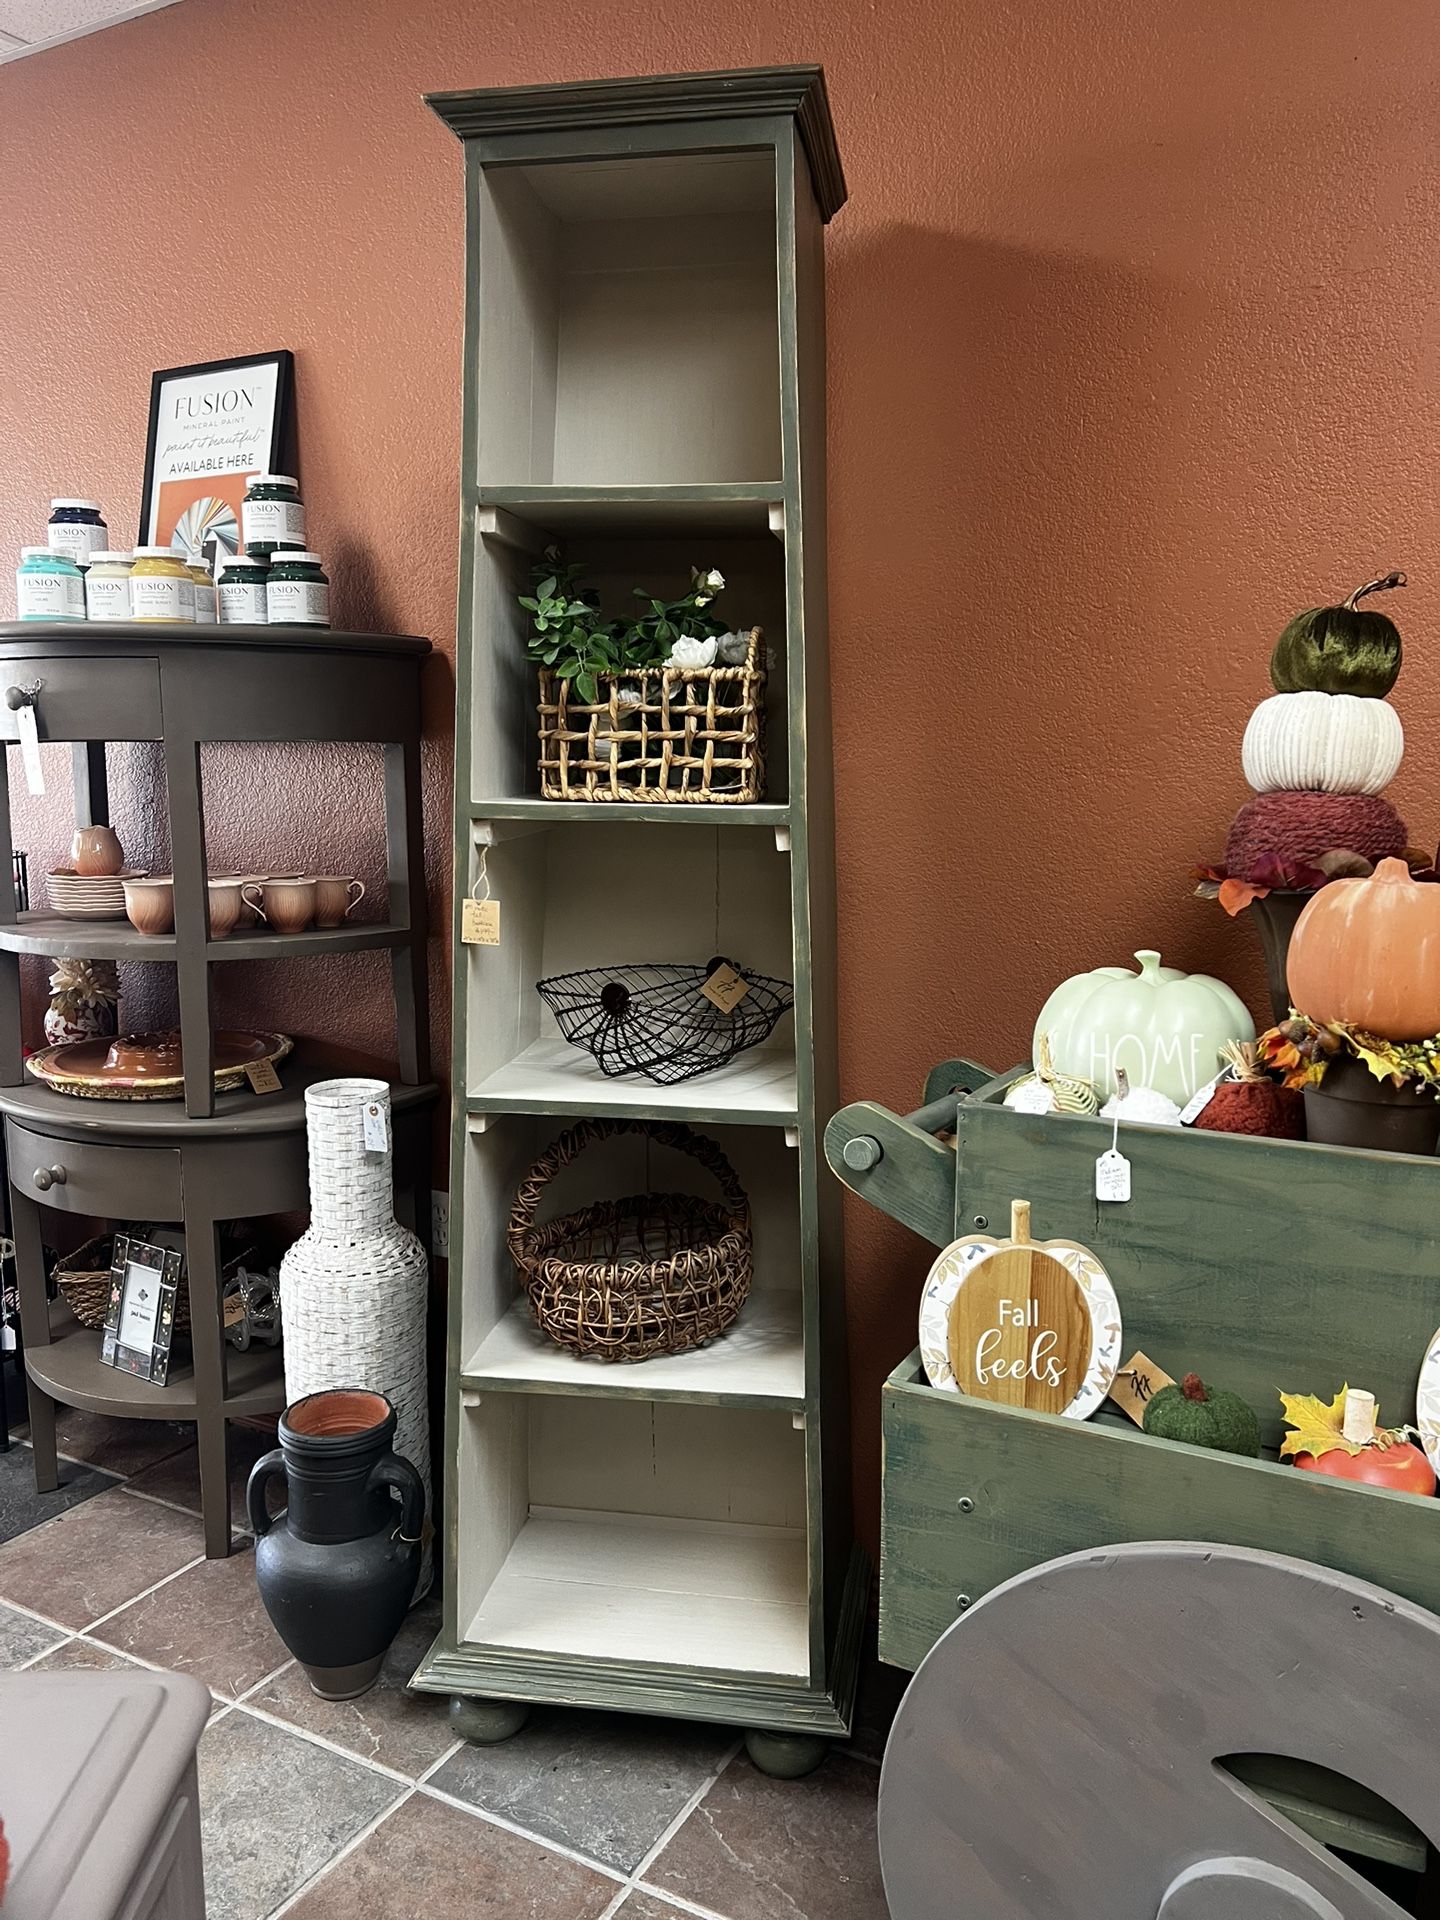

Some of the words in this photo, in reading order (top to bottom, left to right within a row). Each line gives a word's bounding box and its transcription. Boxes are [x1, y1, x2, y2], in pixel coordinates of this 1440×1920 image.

[174, 386, 257, 420] FUSION
[183, 420, 219, 431] MINERAL
[221, 416, 246, 426] PAINT
[169, 456, 224, 475] AVAILABLE
[227, 453, 255, 468] HERE
[247, 504, 281, 513] FUSION
[53, 528, 87, 536] FUSION
[24, 578, 62, 588] FUSION
[88, 582, 122, 592] FUSION
[136, 582, 174, 591] FUSION
[1089, 1032, 1204, 1098] HOME
[999, 1298, 1039, 1327] Fall
[975, 1328, 1068, 1387] feels
